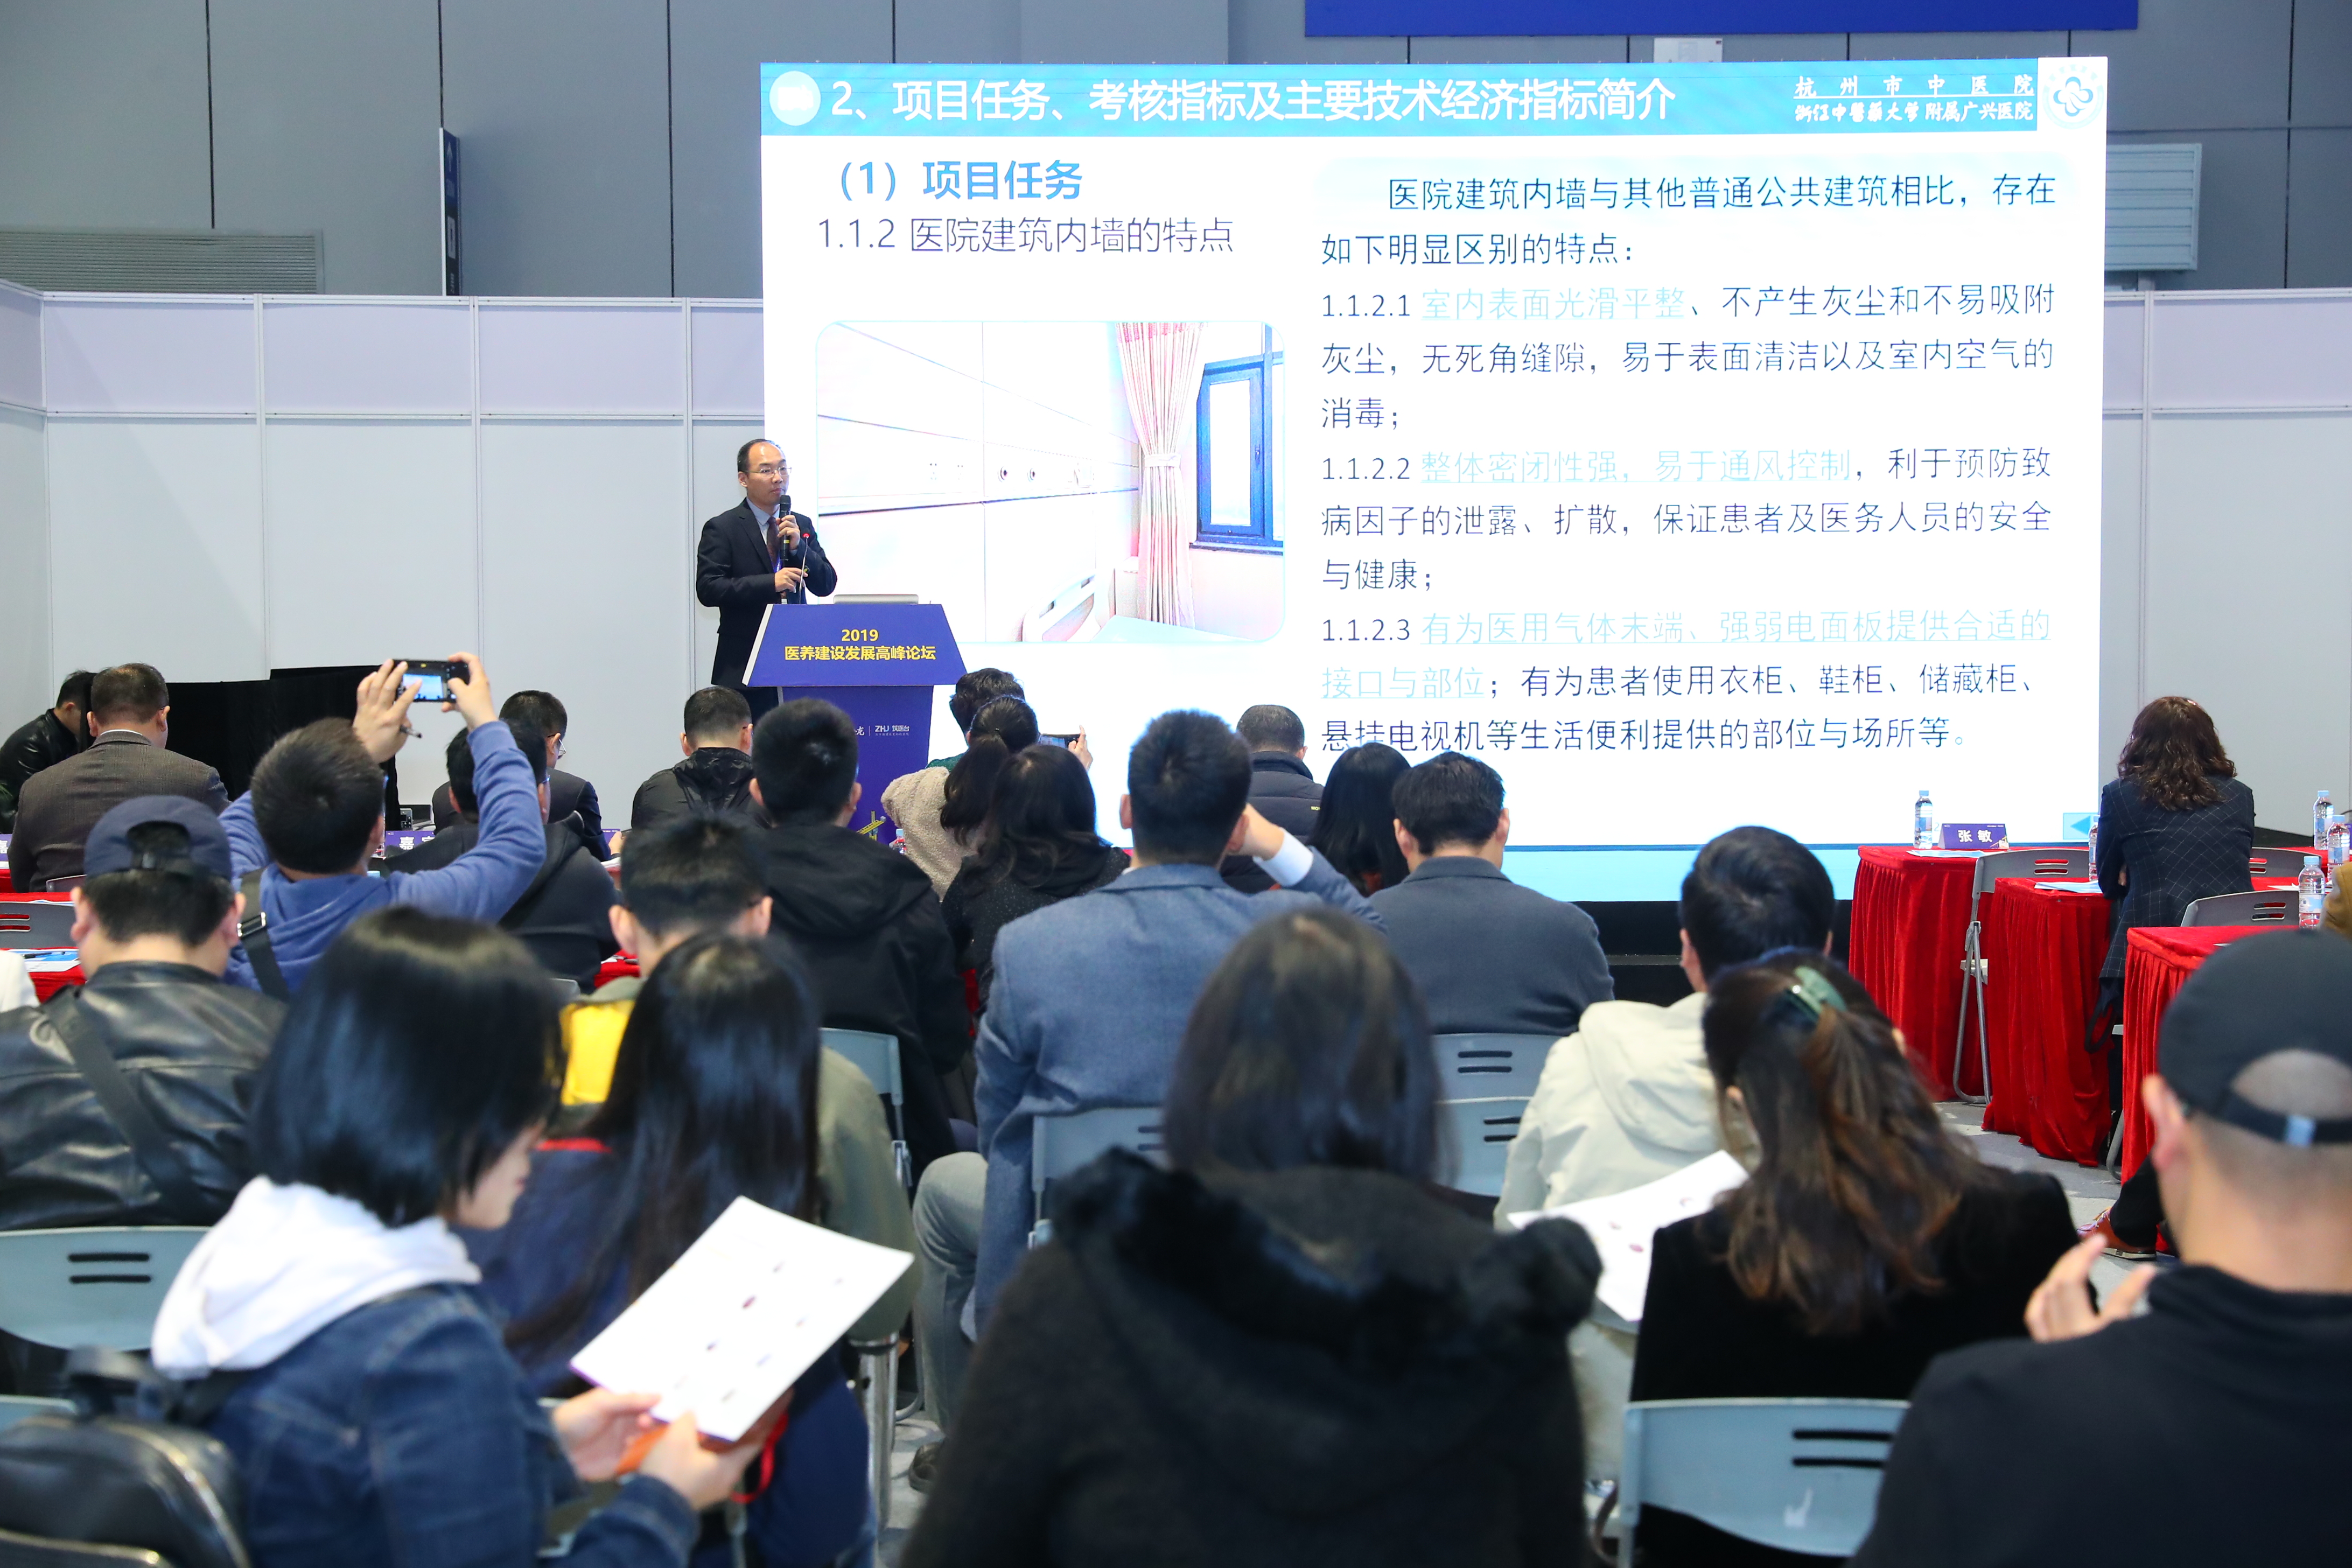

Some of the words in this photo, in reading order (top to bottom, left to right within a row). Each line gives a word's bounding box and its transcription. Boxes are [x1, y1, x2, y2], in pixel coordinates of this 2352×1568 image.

[1795, 74, 2034, 96] 杭州市中医院
[831, 78, 1676, 121] 2、项目任务、考核指标及主要技术经济指标简介
[1389, 174, 2056, 211] 医院建筑内墙与其他普通公共建筑相比，存在
[819, 218, 895, 248] 1.1.2
[911, 217, 1233, 253] 医院建筑内墙的特点
[1322, 294, 1411, 317] 1.1.2.1
[1322, 338, 2053, 375] 灰尘，无死角缝隙，易于表面清洁以及室内空气的
[1322, 457, 1410, 480] 1.1.2.2
[1321, 501, 2051, 536] 病因子的泄露、扩散，保证患者及医务人员的安全
[842, 629, 878, 641] 2019
[1322, 619, 1410, 641] 1.1.2.3
[785, 646, 936, 660] 医养建设发展高峰论坛
[1958, 830, 1992, 843] 张敏
